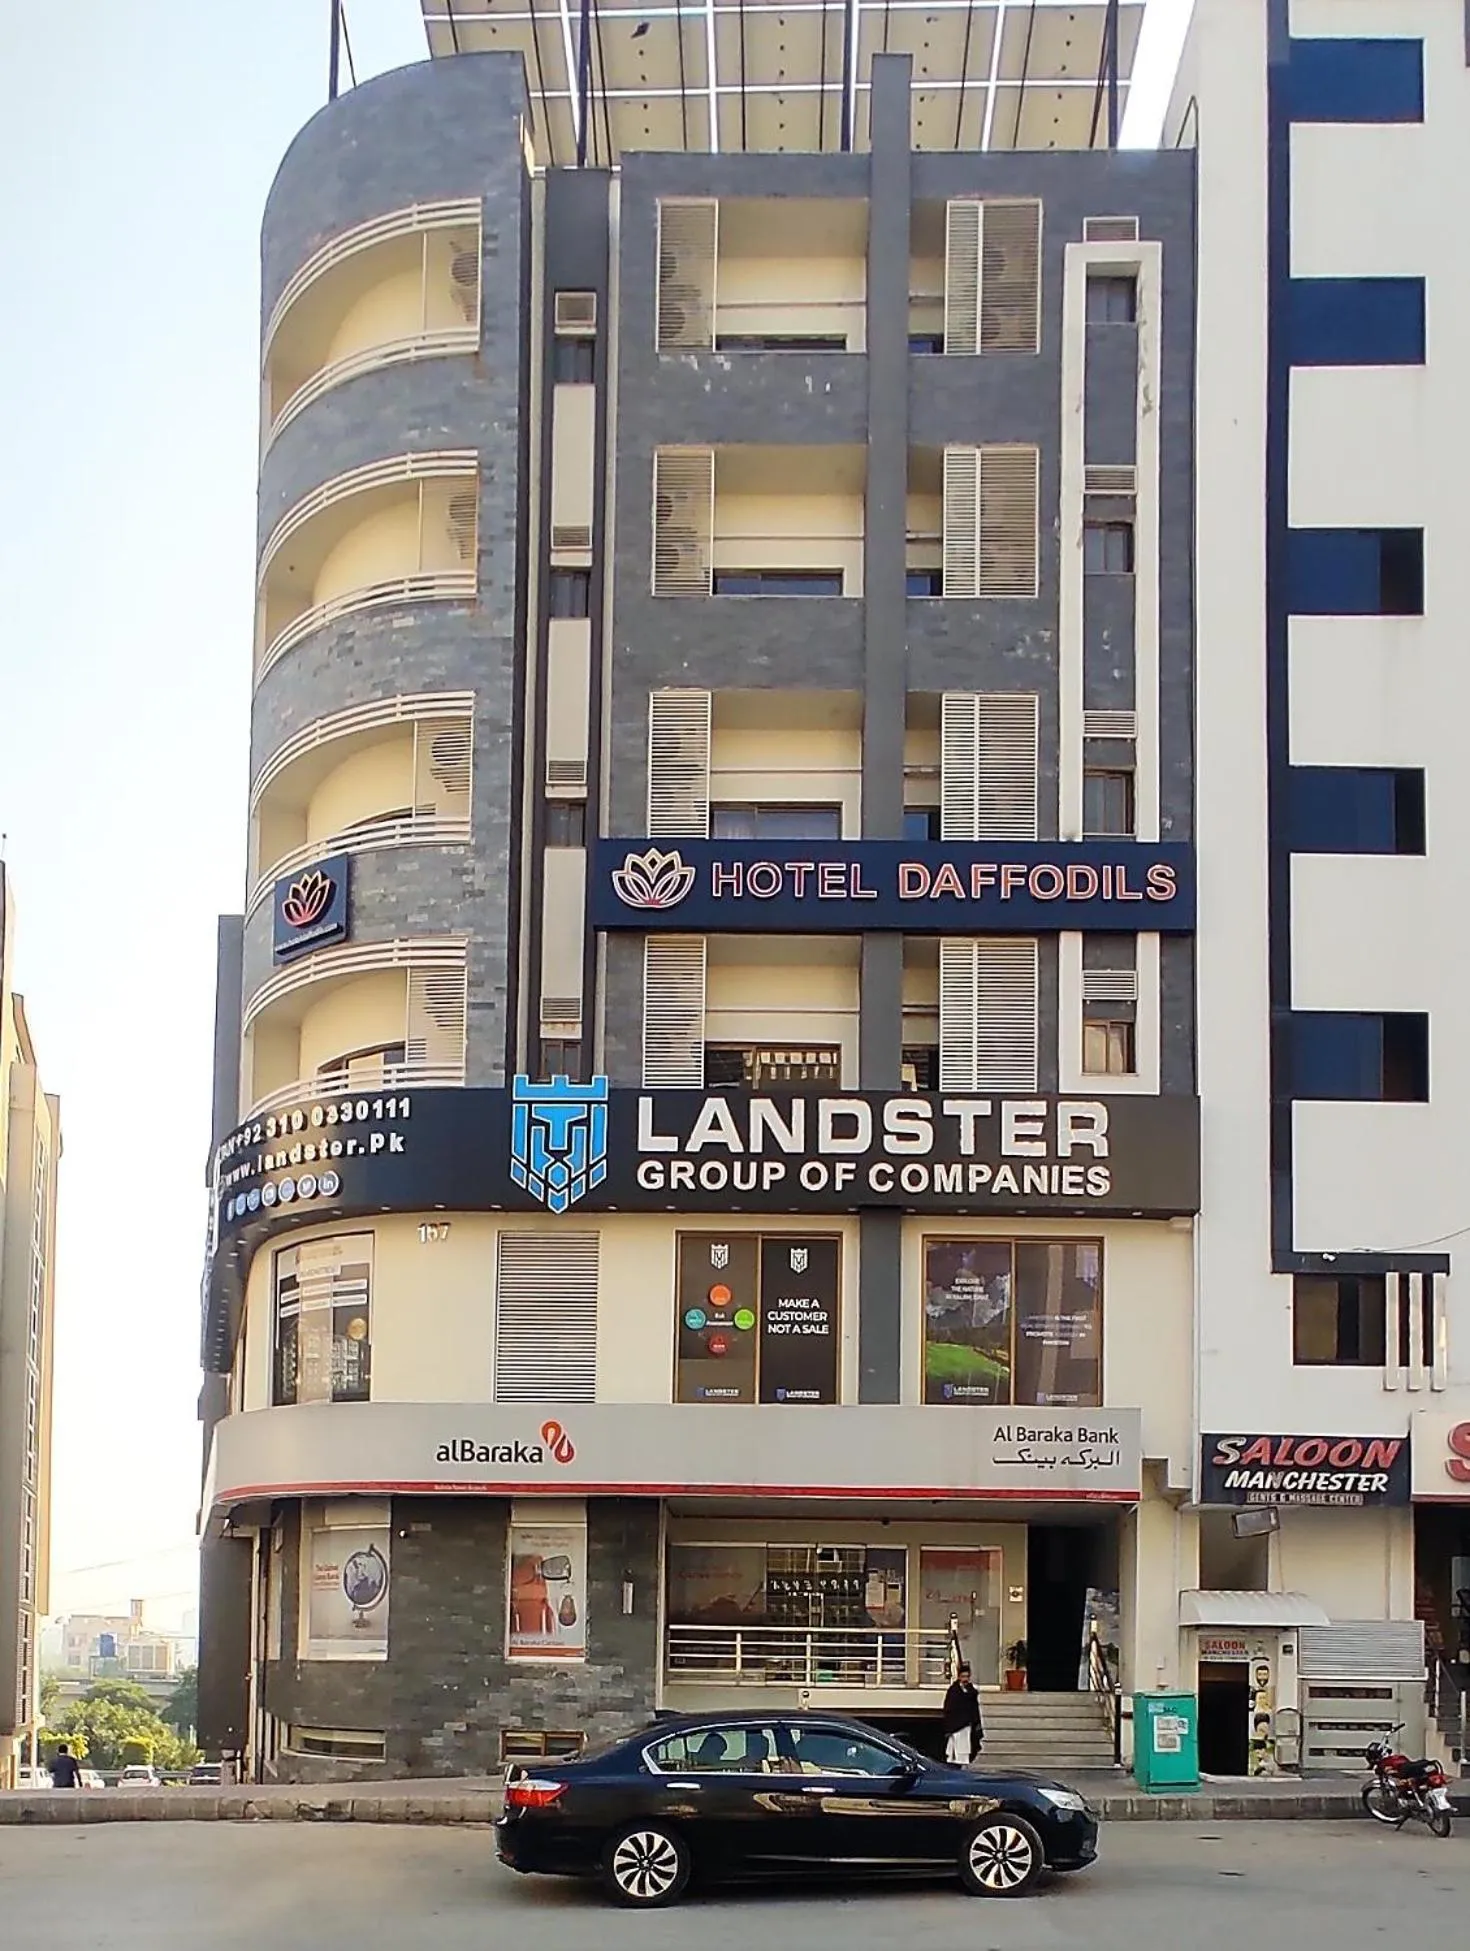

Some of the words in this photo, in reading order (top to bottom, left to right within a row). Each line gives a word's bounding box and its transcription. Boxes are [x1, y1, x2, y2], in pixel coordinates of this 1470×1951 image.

[712, 861, 878, 899] HOTEL
[898, 863, 1177, 901] DAFFODILS
[266, 1110, 304, 1138] 310
[311, 1097, 410, 1127] 0330111
[637, 1096, 1110, 1157] LANDSTER
[637, 1160, 785, 1190] GROUP
[799, 1160, 857, 1191] OF
[868, 1162, 1111, 1196] COMPANIES
[778, 1298, 810, 1309] MAKE
[811, 1298, 820, 1308] A
[767, 1311, 828, 1321] CUSTOMER
[768, 1324, 790, 1334] NOT
[793, 1324, 802, 1334] A
[802, 1324, 829, 1334] SALE
[993, 1426, 1011, 1442] Al
[1016, 1426, 1073, 1442] Baraka
[1077, 1427, 1119, 1444] Bank
[436, 1439, 543, 1463] alBaraka
[1213, 1437, 1399, 1468] SALOON
[1225, 1470, 1389, 1492] MANCHESTER
[1205, 1640, 1246, 1649] SALOON
